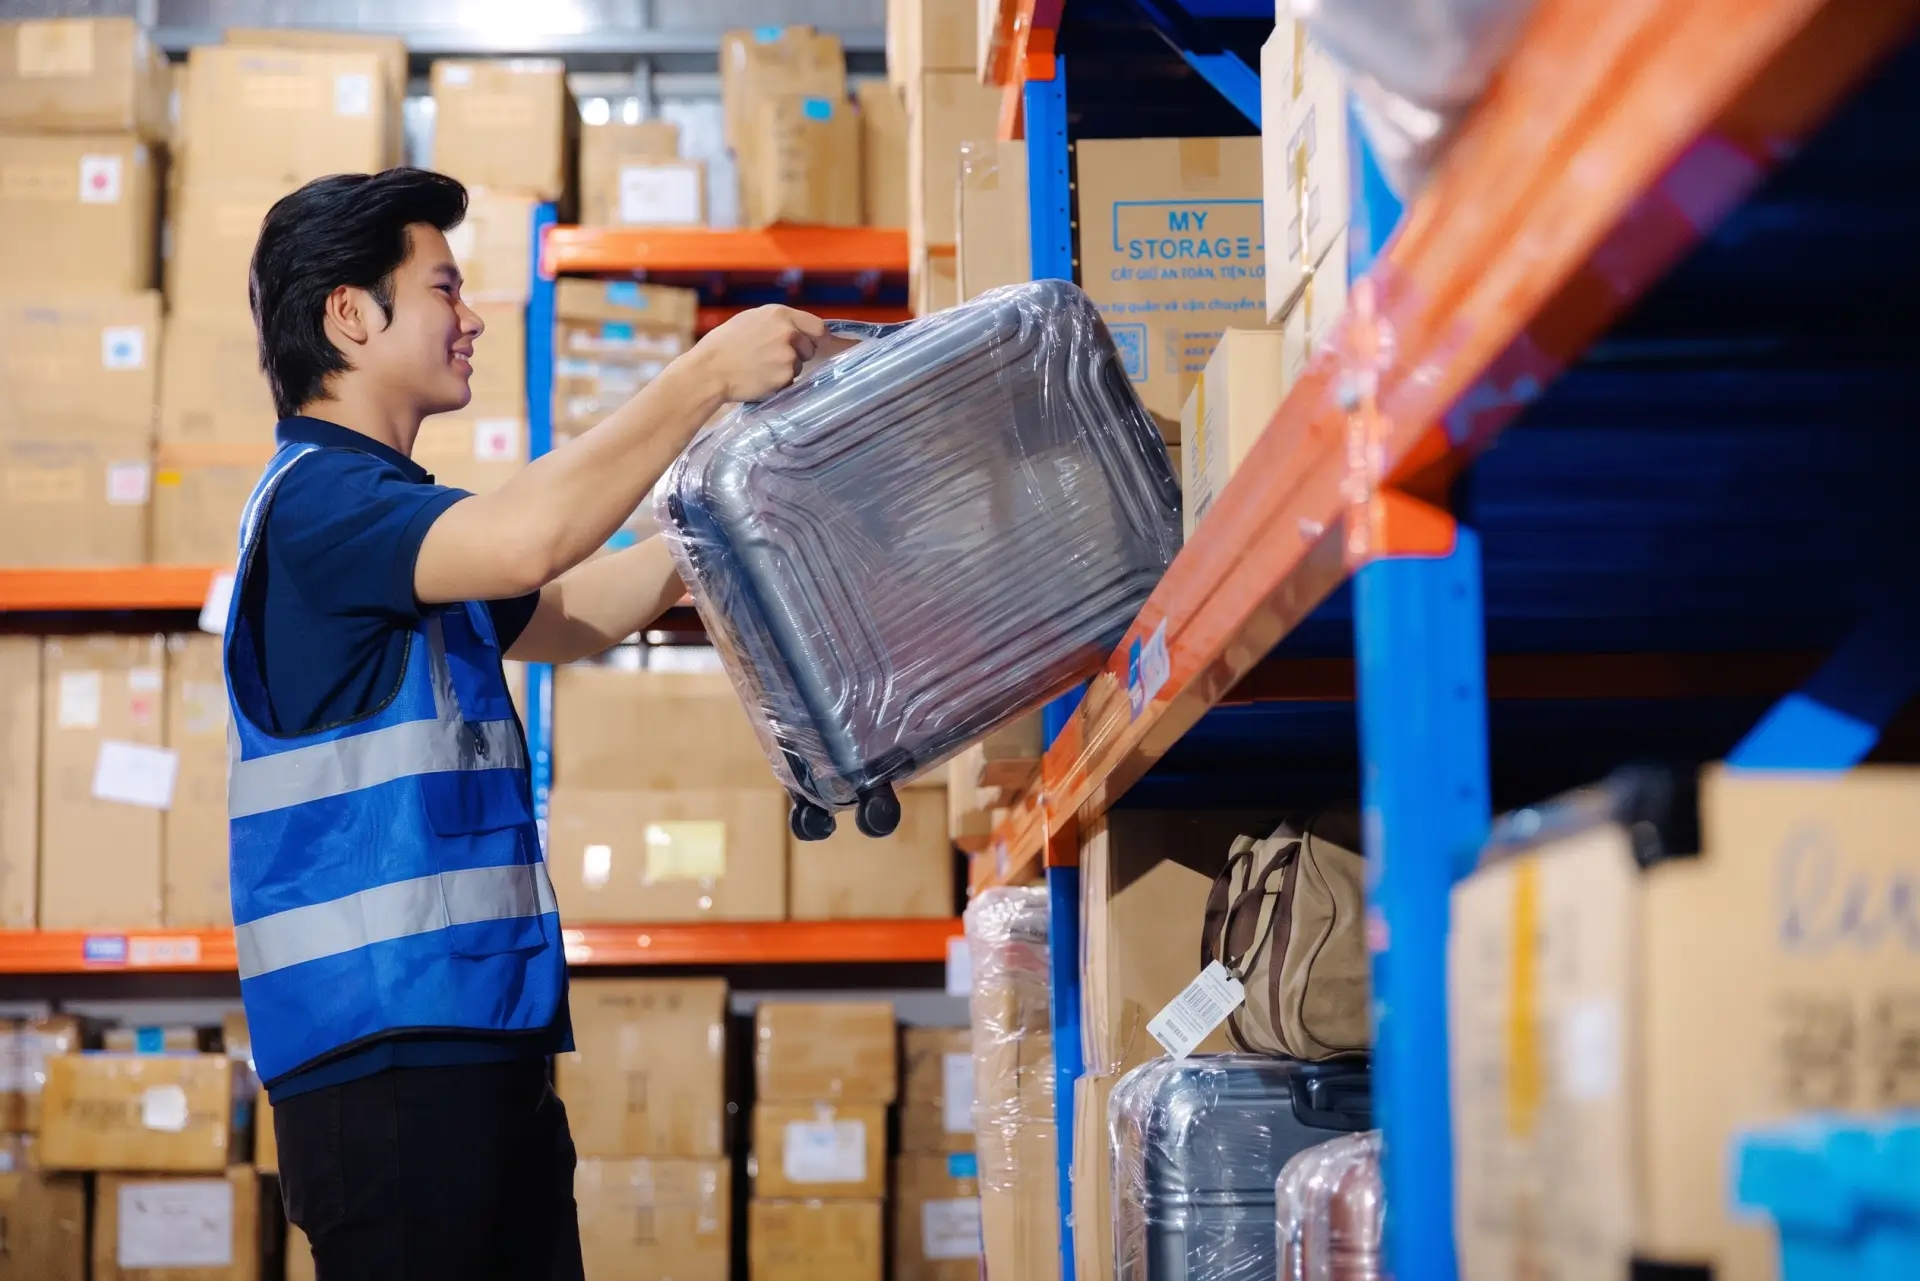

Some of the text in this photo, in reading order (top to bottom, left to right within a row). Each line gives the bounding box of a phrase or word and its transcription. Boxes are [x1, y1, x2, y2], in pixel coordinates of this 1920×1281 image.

[1168, 210, 1208, 231] MY
[1128, 237, 1251, 260] STORAGE
[1160, 267, 1178, 279] AN
